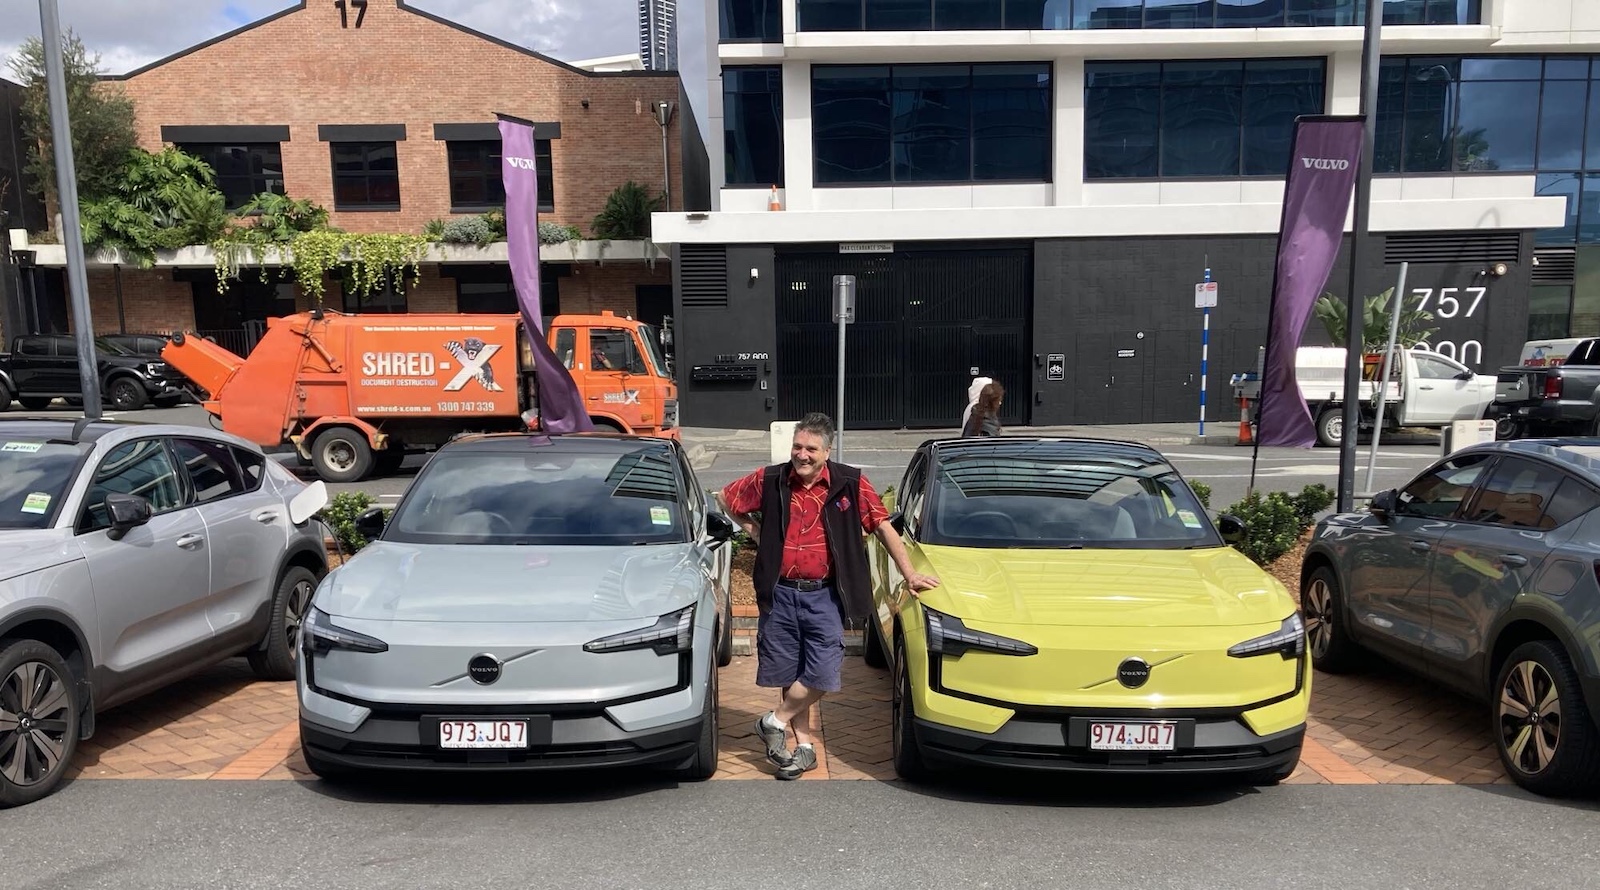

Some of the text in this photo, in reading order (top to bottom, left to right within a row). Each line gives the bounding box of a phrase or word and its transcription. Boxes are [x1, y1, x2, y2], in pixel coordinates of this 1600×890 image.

[335, 0, 368, 28] 17
[1301, 157, 1349, 170] VOLVO
[1412, 287, 1487, 318] 757
[361, 378, 438, 387] DOCUMENT DESTRUCTION
[357, 401, 495, 412] www.shred-x.com.au 1300 747 339
[442, 721, 525, 742] 973 JQ7
[1093, 723, 1173, 744] 974 JQ7
